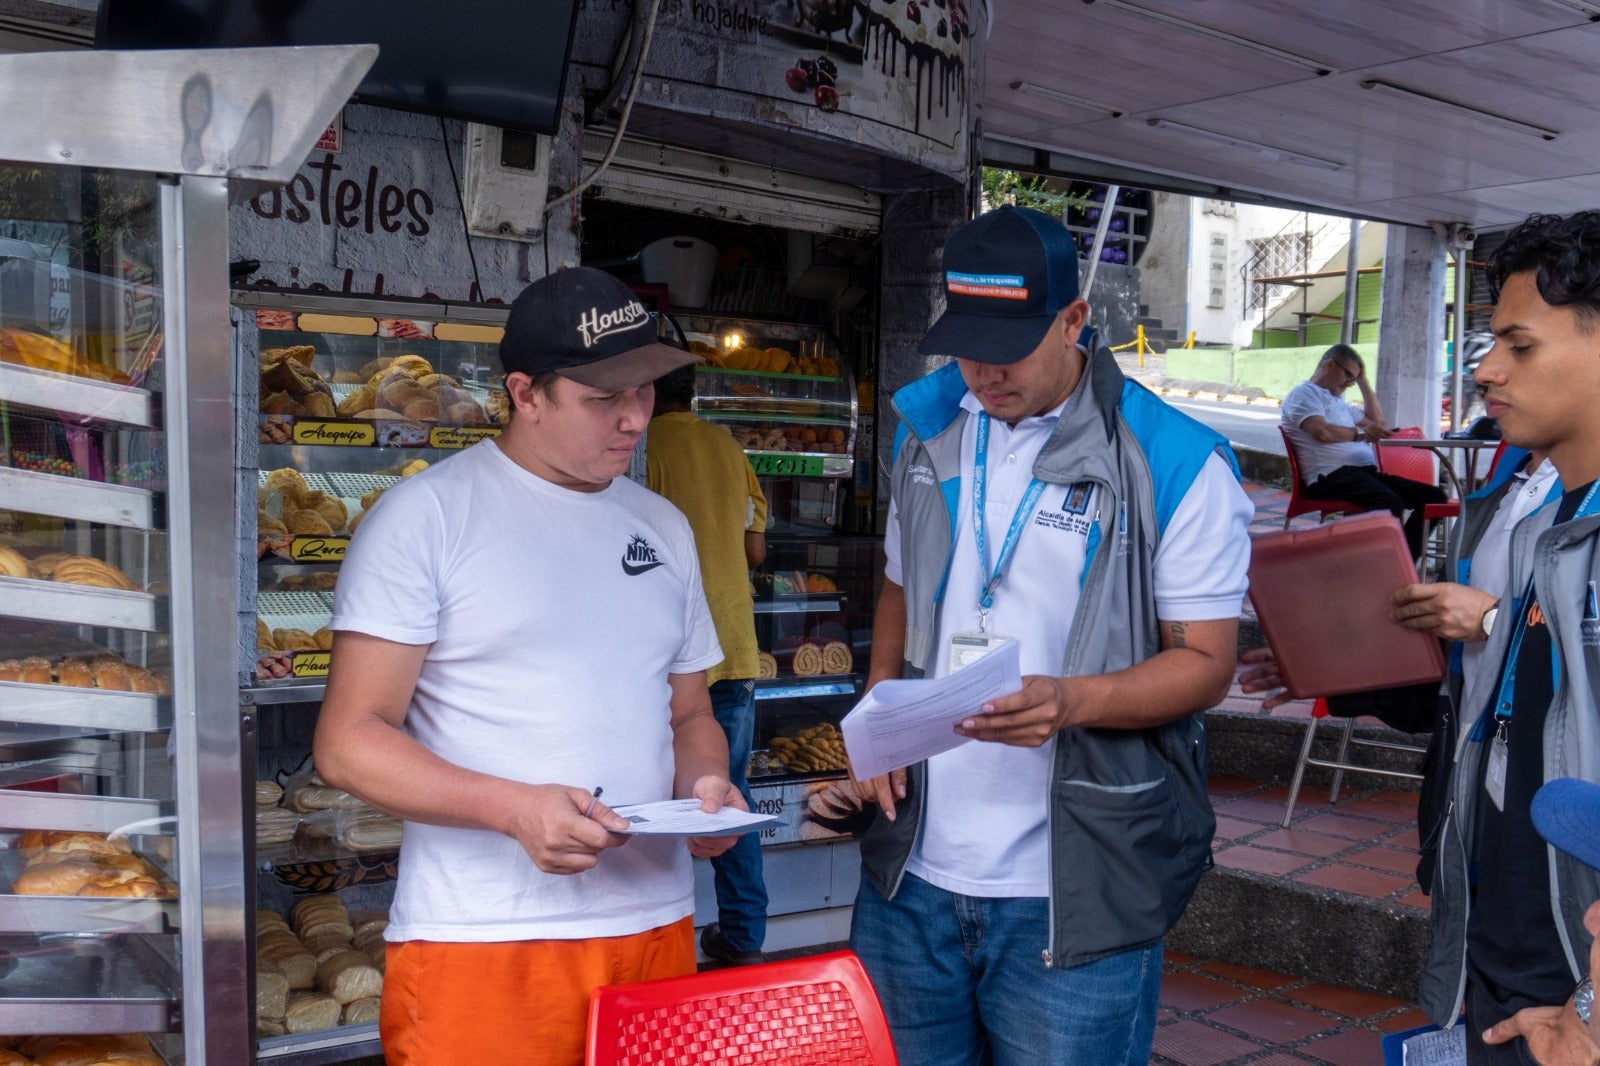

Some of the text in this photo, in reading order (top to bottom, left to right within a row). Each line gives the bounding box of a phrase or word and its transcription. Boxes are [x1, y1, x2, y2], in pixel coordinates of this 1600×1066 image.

[251, 153, 434, 237] asteles
[300, 423, 367, 444] Arequipe
[1074, 517, 1090, 528] Med
[297, 540, 346, 558] Que
[627, 544, 659, 562] NIKE
[294, 655, 329, 674] Haw
